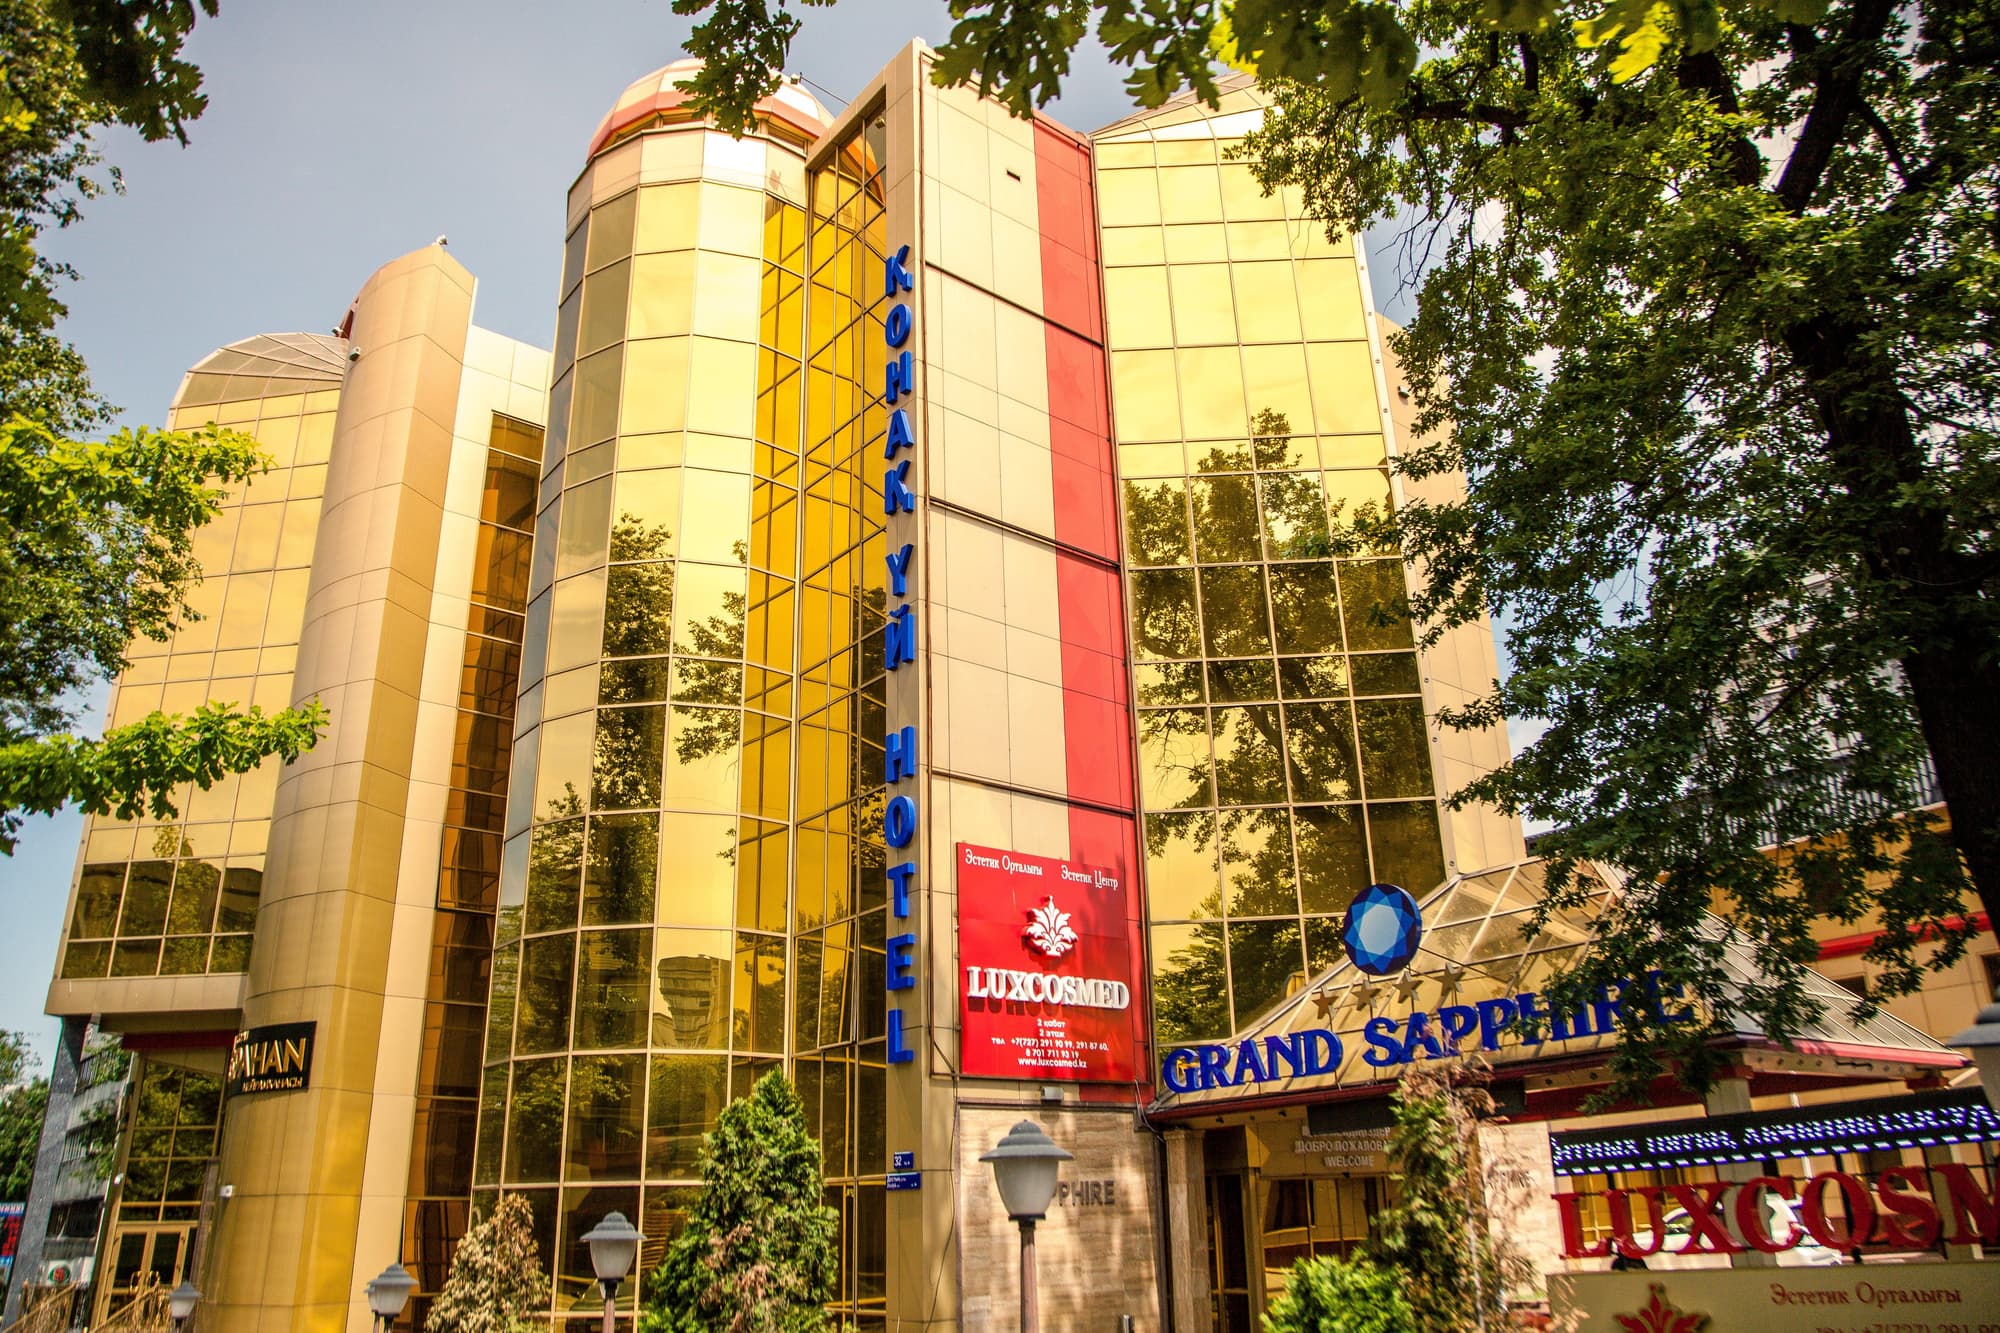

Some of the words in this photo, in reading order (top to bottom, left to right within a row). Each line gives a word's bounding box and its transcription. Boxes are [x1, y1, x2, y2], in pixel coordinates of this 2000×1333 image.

[965, 848, 1000, 869] Эстетик
[1061, 865, 1092, 884] Эстетик
[1094, 870, 1118, 891] Центр
[886, 725, 915, 1064] HOTEL
[966, 966, 1130, 1010] LUXCOSMED
[1032, 1049, 1045, 1057] 701
[1047, 1049, 1059, 1057] 711
[1040, 1039, 1053, 1047] 291
[1018, 1058, 1087, 1069] www.luxcosmed.kz
[1162, 1028, 1344, 1094] GRAND
[1295, 1140, 1333, 1154] ДОБРО
[1324, 1155, 1374, 1168] WELCOME
[1055, 1180, 1115, 1207] PHIRE
[1769, 1281, 1850, 1305] Эстетик
